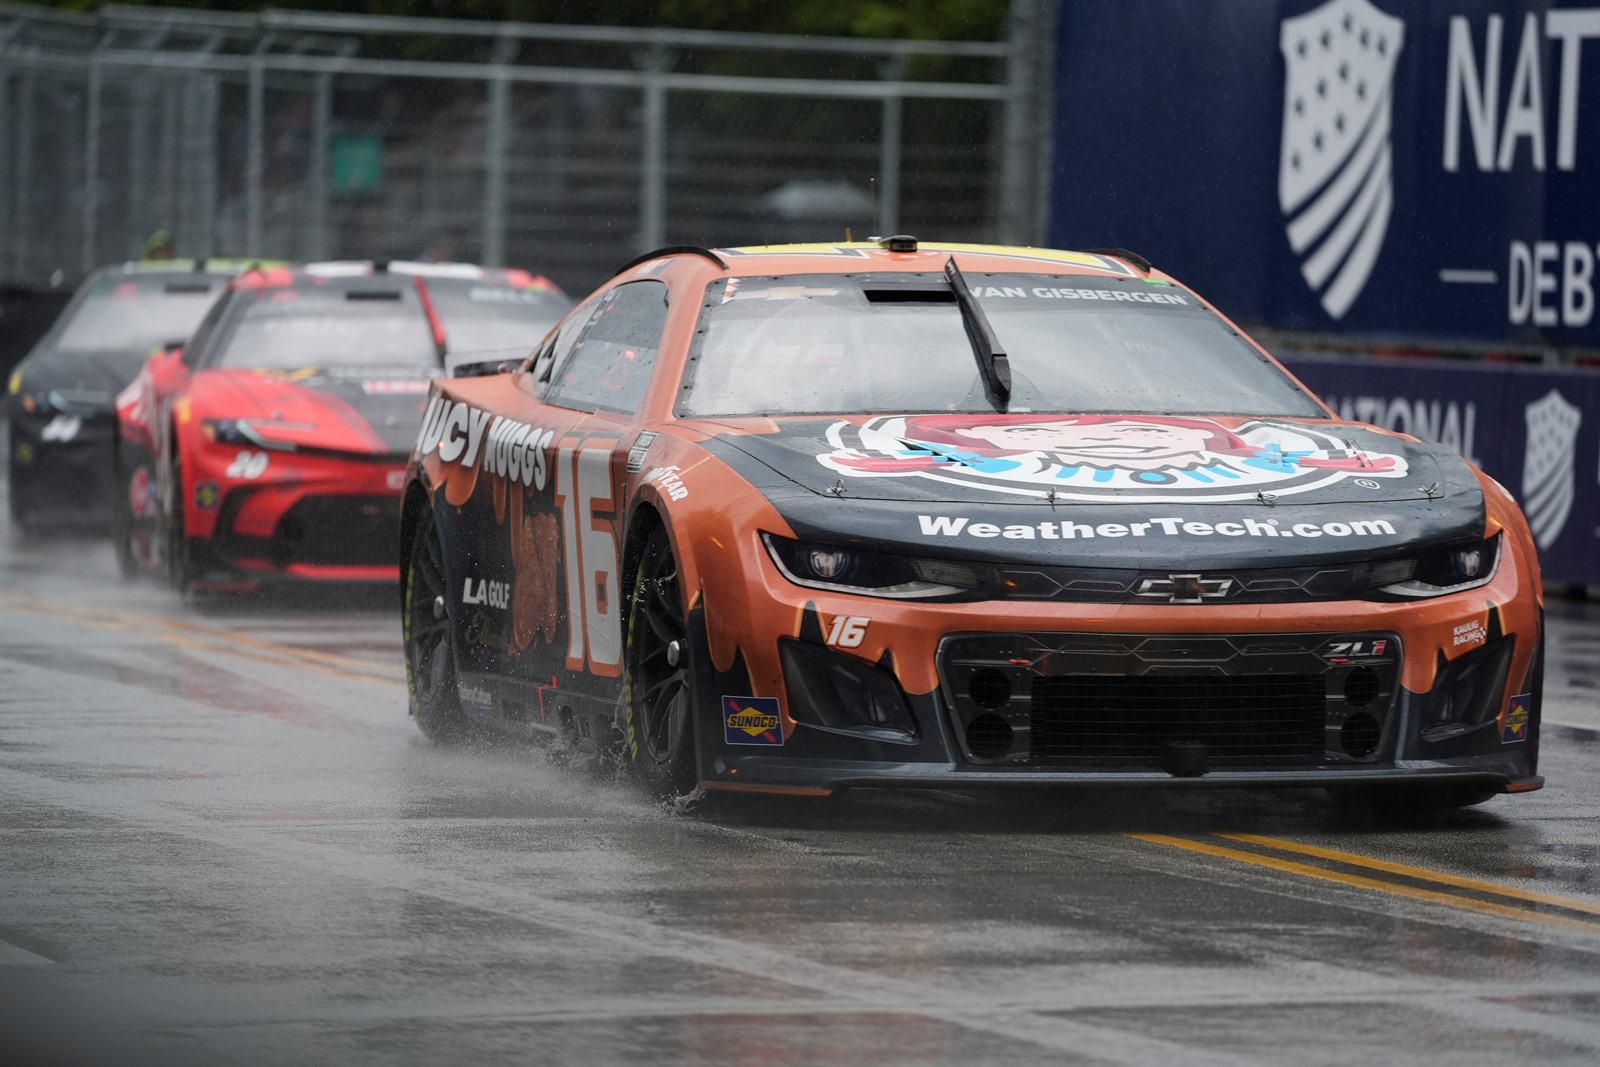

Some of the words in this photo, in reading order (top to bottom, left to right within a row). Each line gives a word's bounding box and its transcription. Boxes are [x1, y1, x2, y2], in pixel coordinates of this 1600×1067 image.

[969, 286, 1028, 298] VAN
[1032, 287, 1190, 306] GISBERGEN
[1508, 241, 1600, 326] DEB
[1325, 396, 1482, 471] TIONAL
[484, 415, 554, 491] NUGGS
[554, 440, 622, 672] 16
[463, 577, 488, 605] LA
[488, 580, 510, 609] GOLF
[827, 615, 871, 648] 16
[1323, 640, 1387, 657] ZL1
[729, 715, 778, 729] SUNOCO
